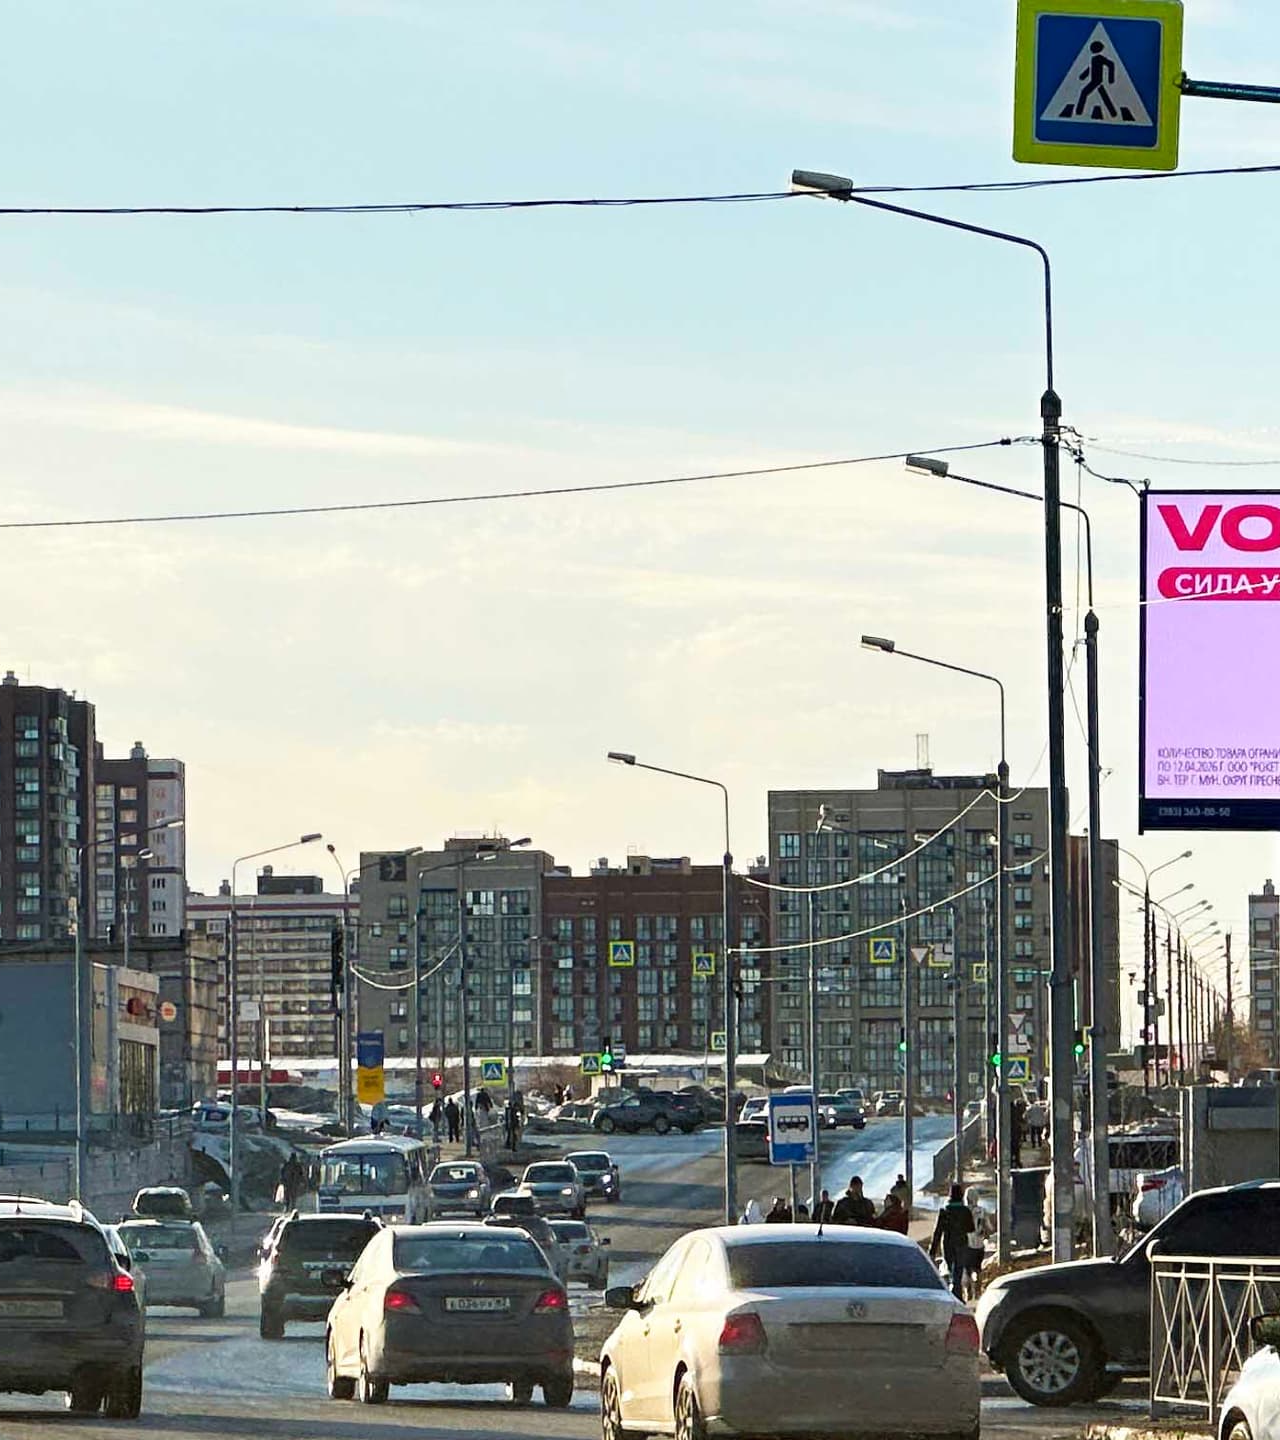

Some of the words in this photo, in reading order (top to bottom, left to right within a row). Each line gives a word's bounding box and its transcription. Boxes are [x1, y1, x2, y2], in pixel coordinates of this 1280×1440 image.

[1175, 574, 1253, 595] СИЛА
[1158, 748, 1214, 759] КОЛИЧЕСТВО
[1216, 748, 1246, 759] ТОВАРА
[1158, 761, 1171, 772] ПО
[1227, 761, 1248, 773] ООО
[1223, 775, 1247, 786] ОКРУГ
